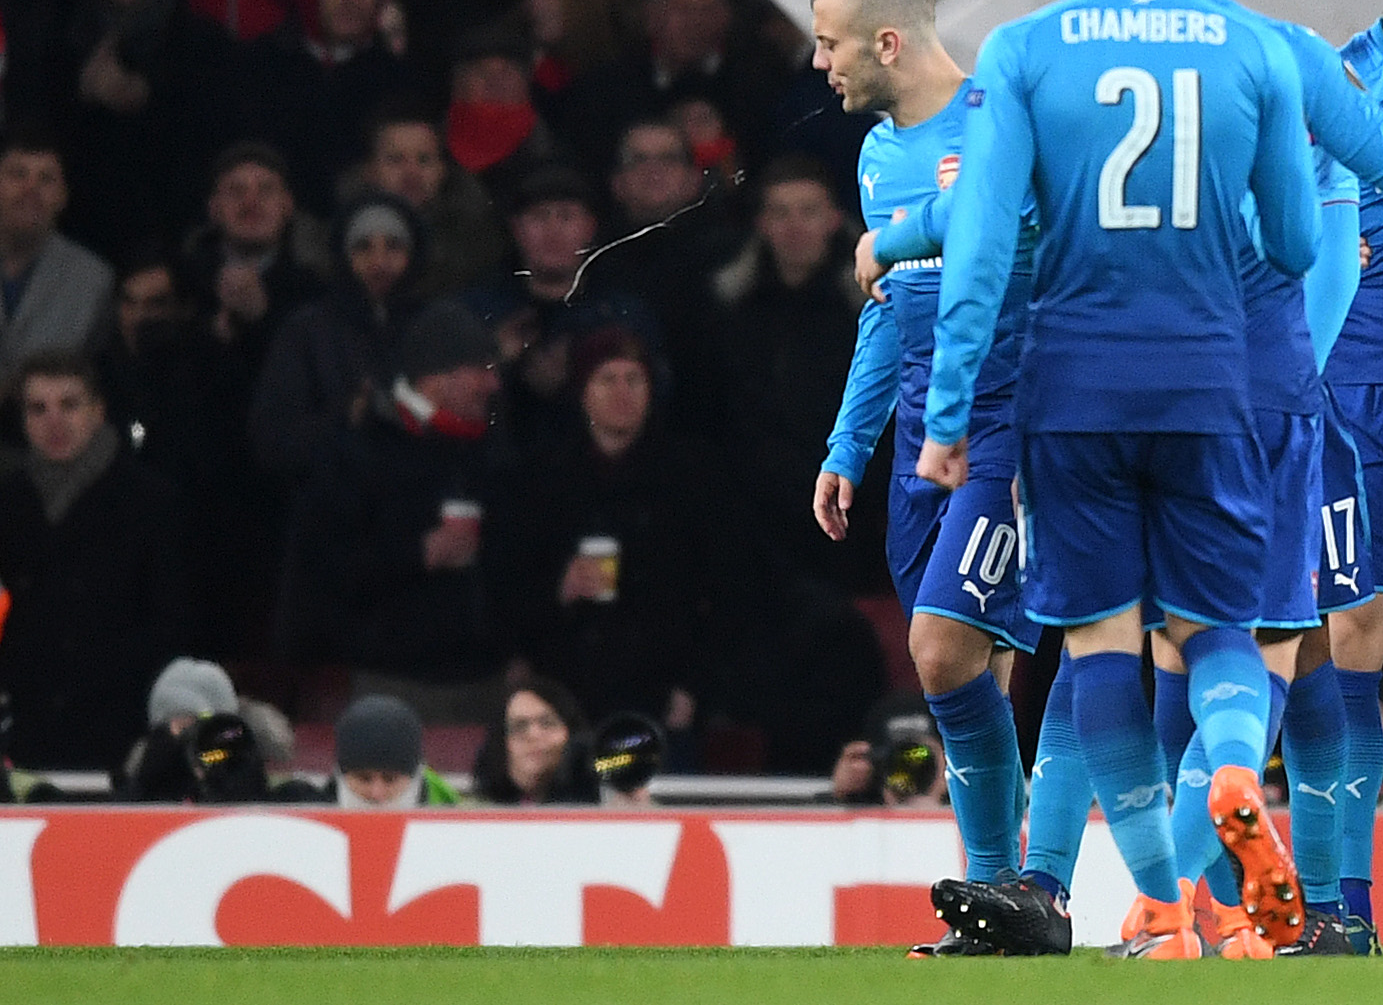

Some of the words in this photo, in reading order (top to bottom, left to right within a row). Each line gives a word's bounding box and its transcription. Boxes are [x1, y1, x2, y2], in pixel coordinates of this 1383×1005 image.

[1060, 7, 1227, 45] CHAMBERS
[1095, 66, 1200, 229] 21
[958, 516, 1017, 585] 10
[1321, 496, 1356, 570] 17
